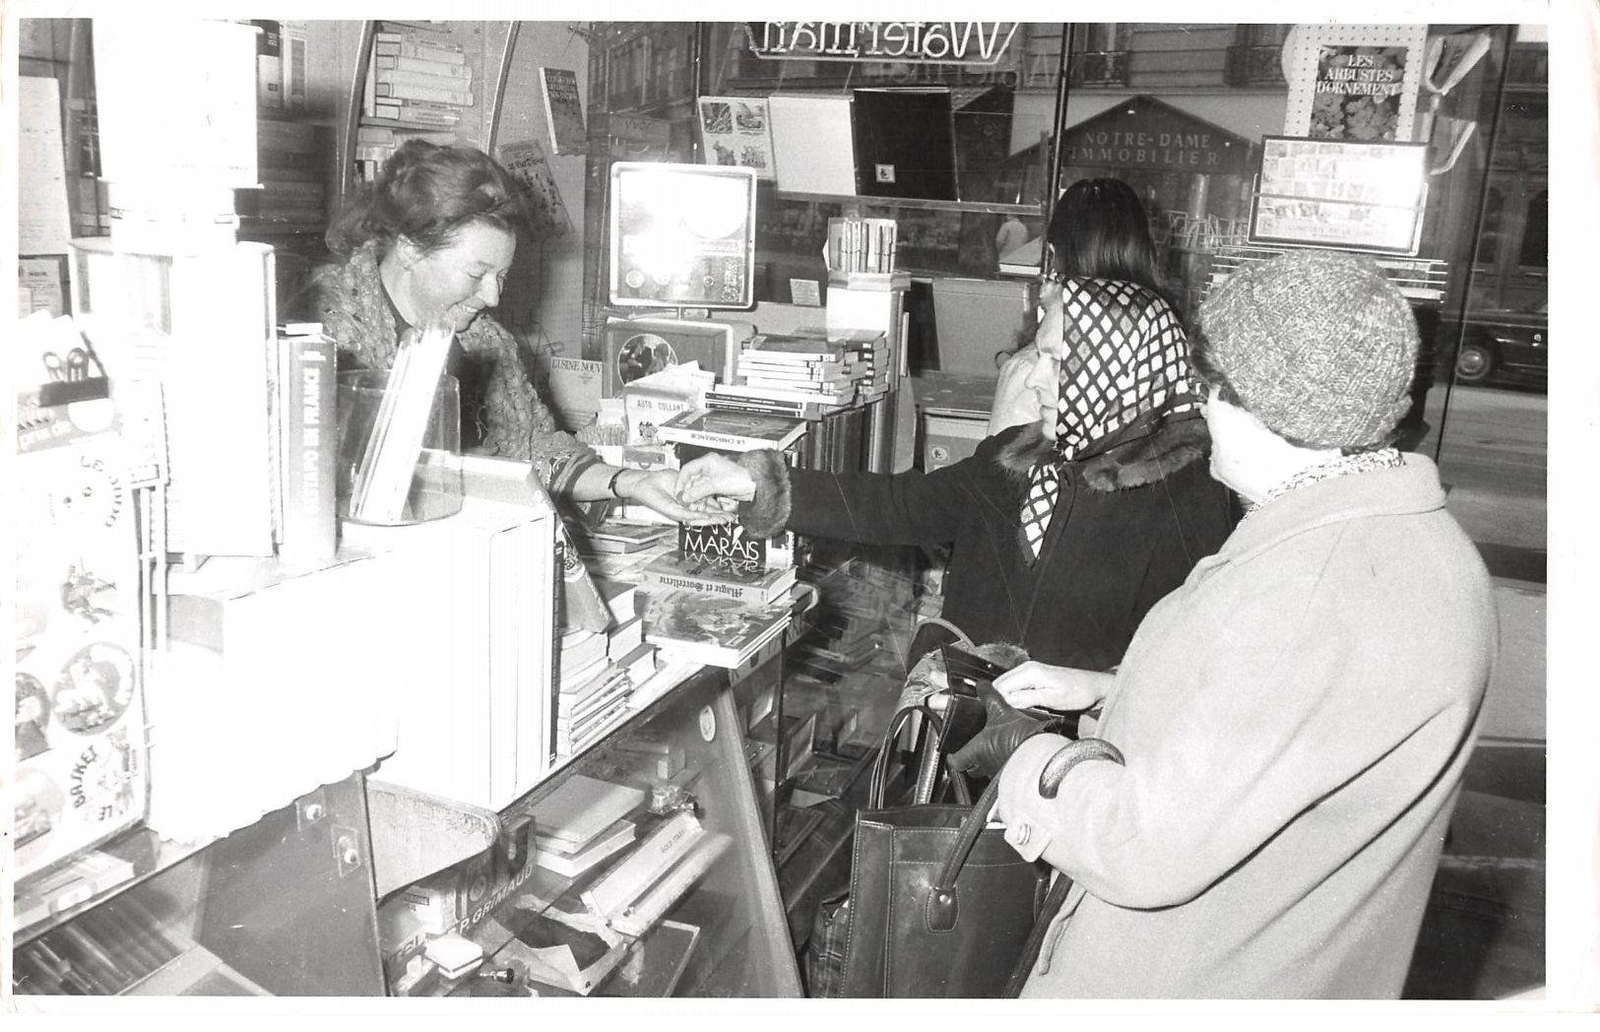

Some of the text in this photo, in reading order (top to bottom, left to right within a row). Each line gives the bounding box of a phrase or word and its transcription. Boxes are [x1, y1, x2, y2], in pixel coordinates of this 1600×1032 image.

[1347, 54, 1374, 67] LES
[1324, 68, 1394, 82] ARBUSTES
[1316, 81, 1403, 96] D'ORNEMENT
[1070, 146, 1219, 166] IMMOBILIER
[303, 366, 321, 425] FRANCE
[637, 399, 684, 412] AUTO COLLANT
[303, 428, 320, 448] EN
[80, 455, 104, 472] LE
[684, 531, 759, 560] MARAIS
[658, 576, 744, 598] Magie et Sorcellerie
[97, 804, 113, 821] LE
[472, 864, 533, 924] GRIMAUD
